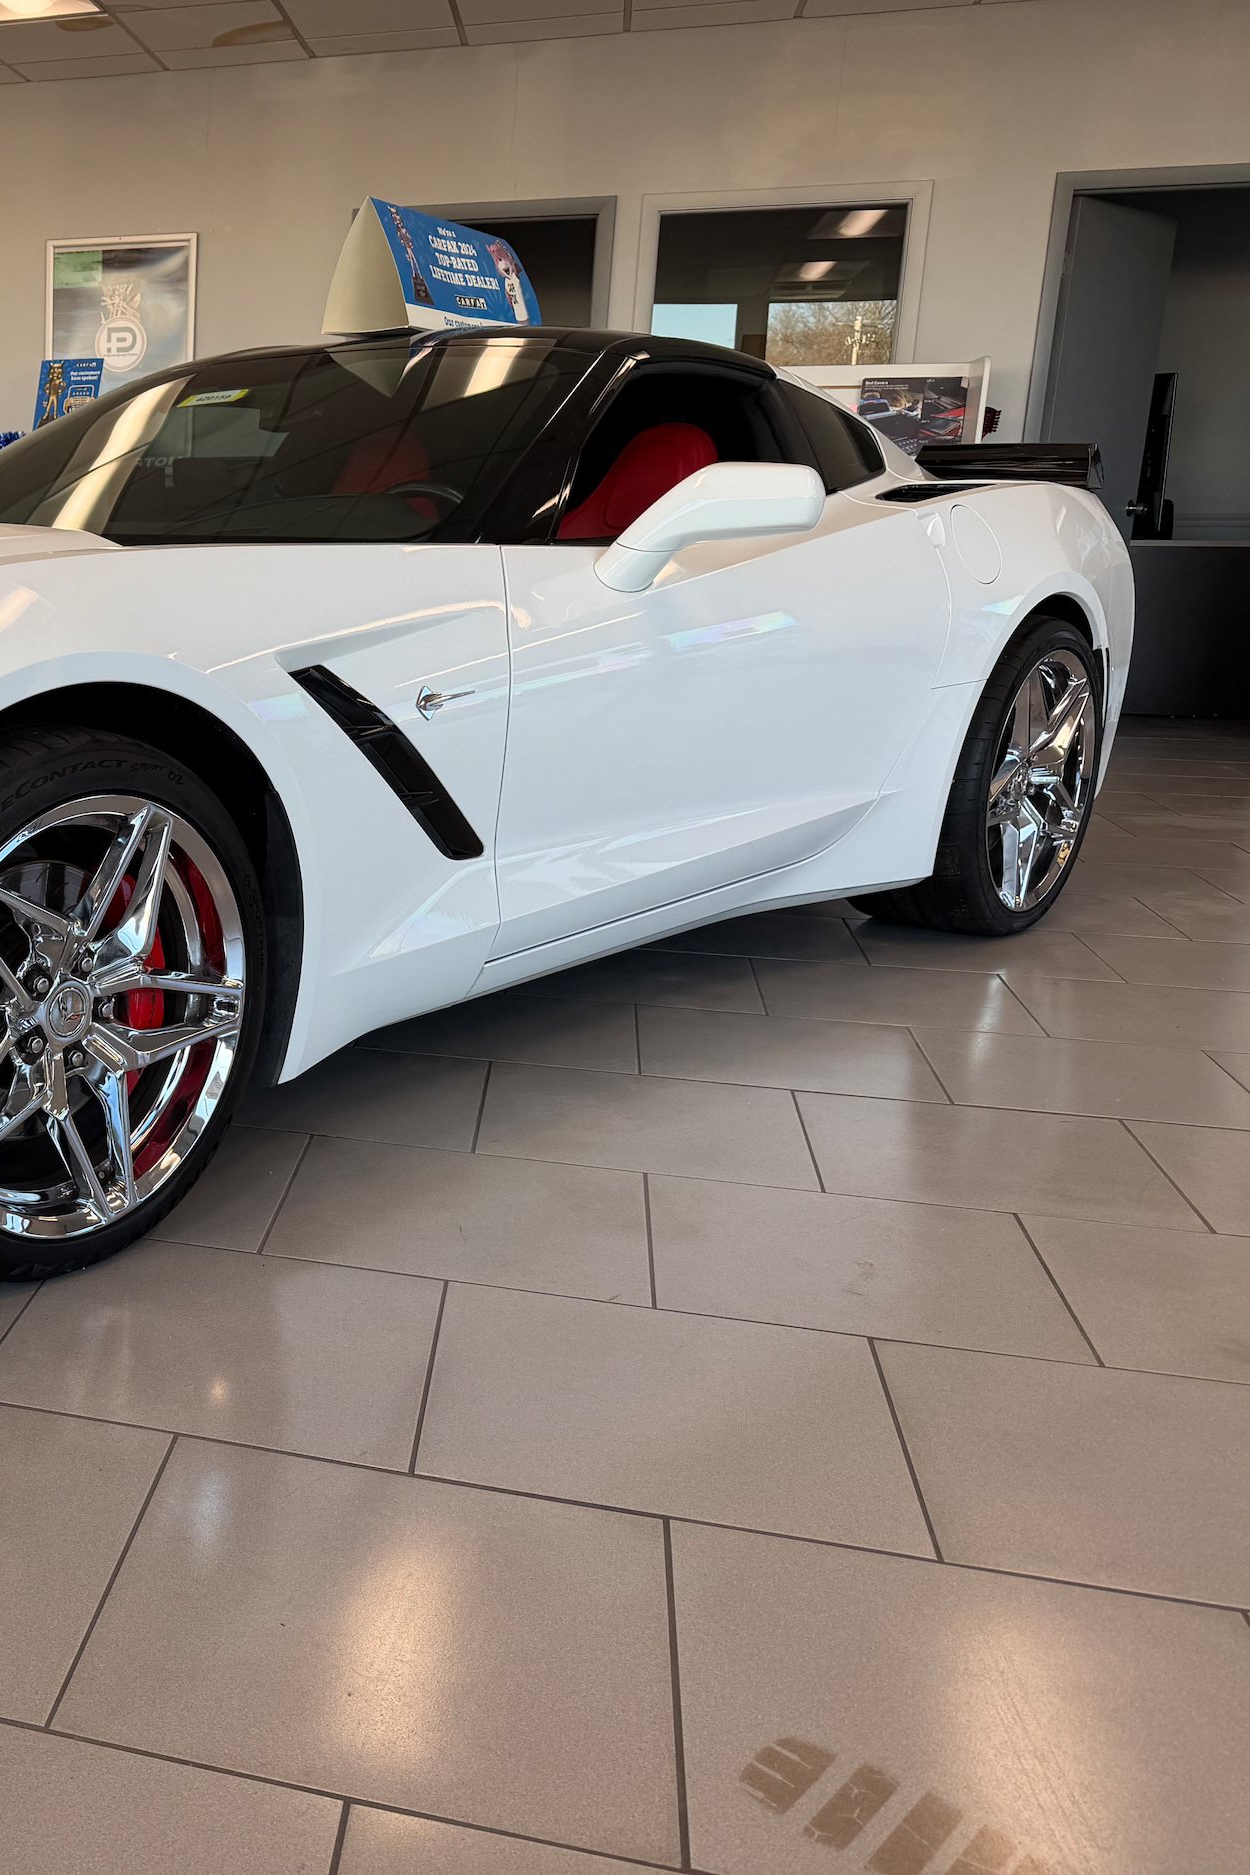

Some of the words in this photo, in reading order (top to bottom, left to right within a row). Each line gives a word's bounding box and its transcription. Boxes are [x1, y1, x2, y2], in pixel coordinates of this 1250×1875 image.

[428, 235, 459, 254] CARFAX
[458, 242, 478, 257] 2024
[434, 252, 479, 272] TOP-RATED
[429, 265, 466, 286] LIFETIME
[465, 274, 501, 290] DEALER!
[455, 295, 487, 310] CARFAX
